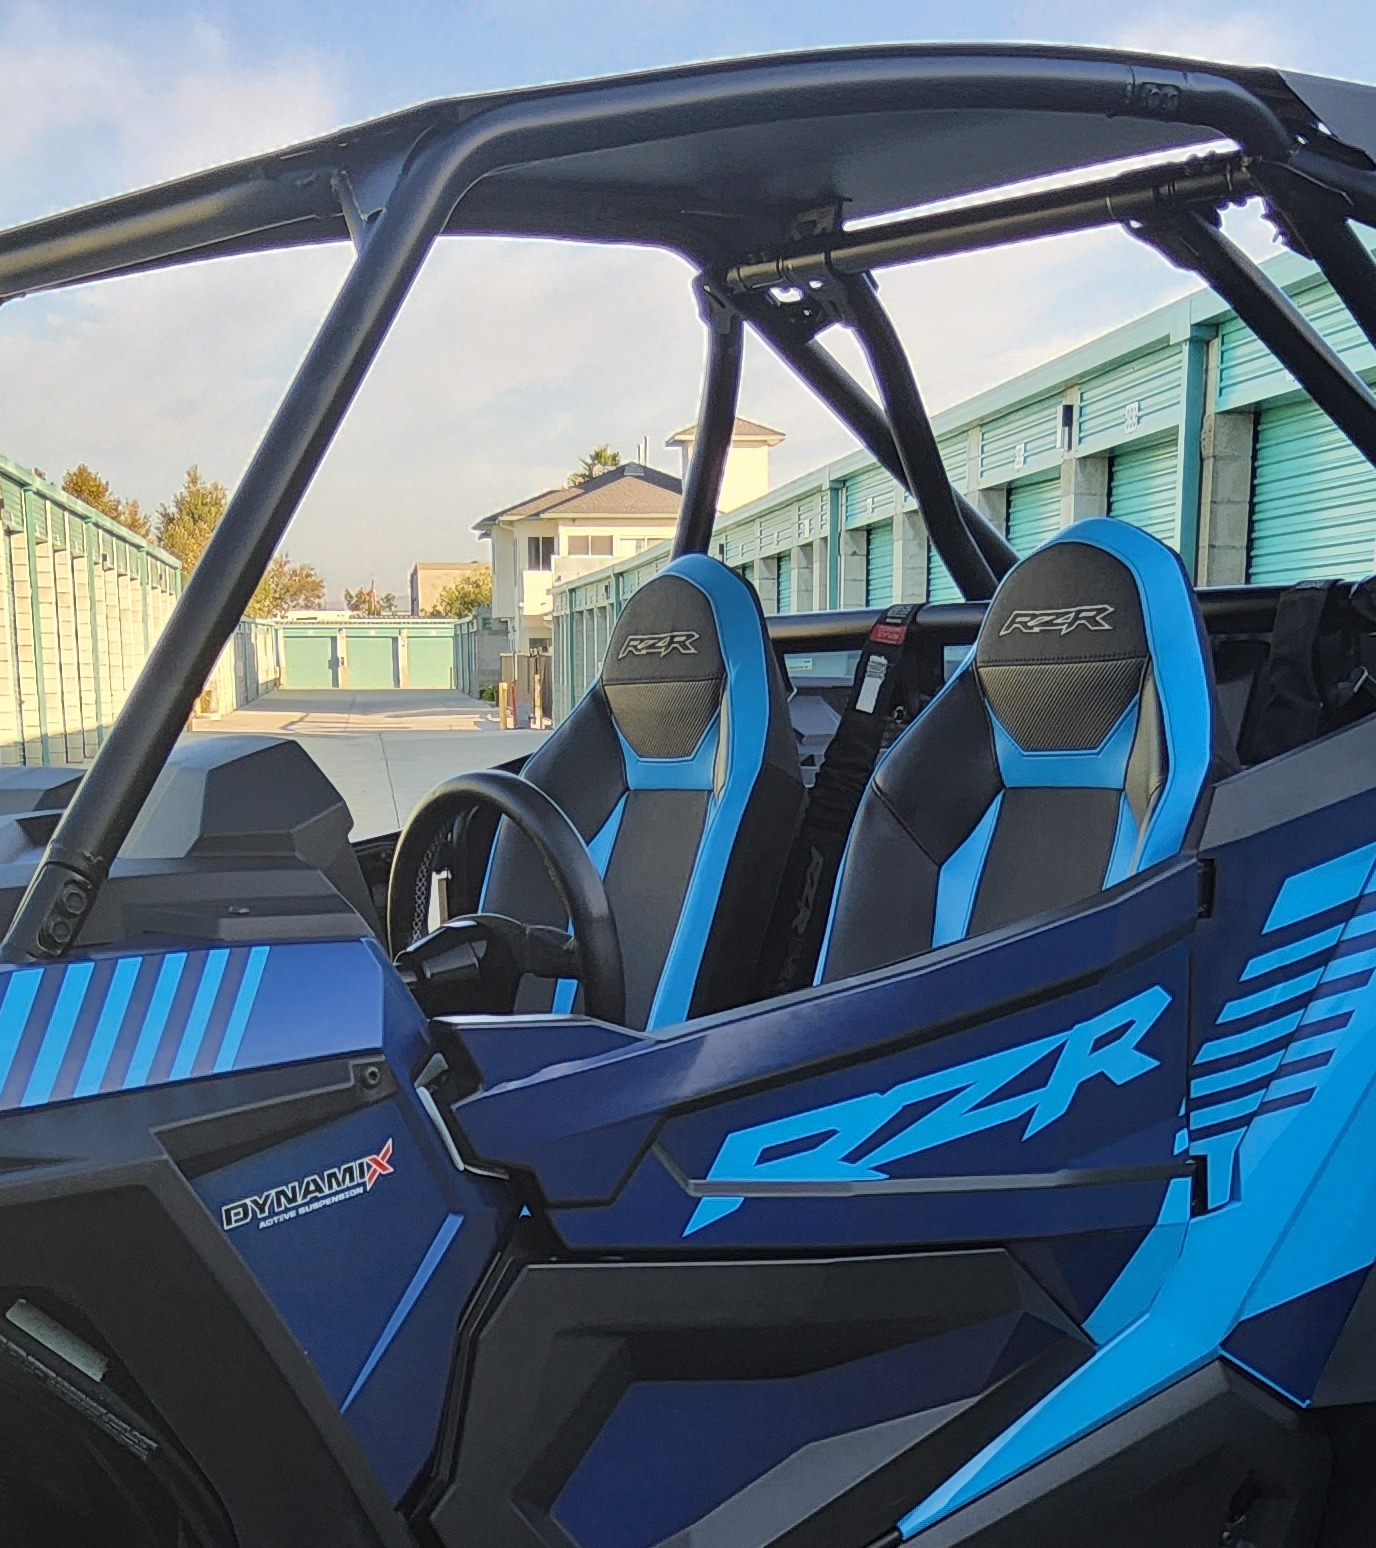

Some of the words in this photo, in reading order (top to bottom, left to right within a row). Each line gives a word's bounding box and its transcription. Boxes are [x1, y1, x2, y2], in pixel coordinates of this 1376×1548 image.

[998, 604, 1115, 636] RZR
[618, 631, 700, 660] RZR
[682, 985, 1173, 1239] RZR
[222, 1138, 395, 1231] DYNAMIX
[258, 1210, 297, 1229] ACTIVE
[297, 1186, 364, 1216] SUSPENSION
